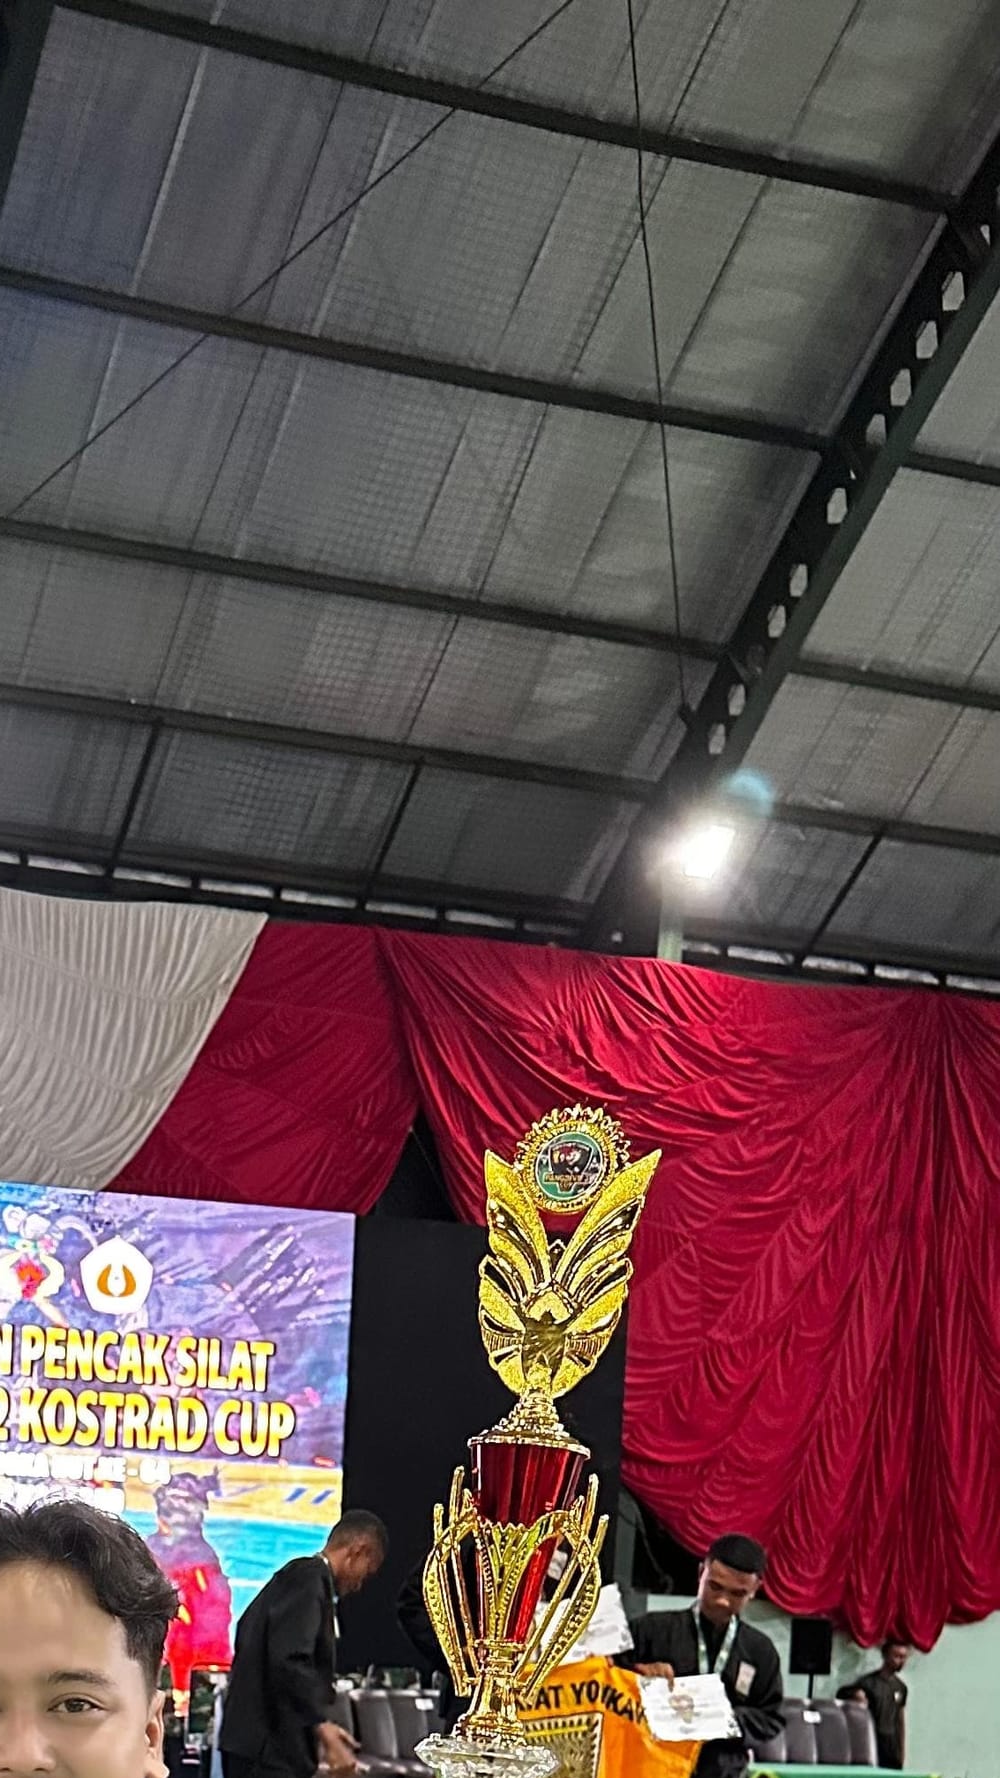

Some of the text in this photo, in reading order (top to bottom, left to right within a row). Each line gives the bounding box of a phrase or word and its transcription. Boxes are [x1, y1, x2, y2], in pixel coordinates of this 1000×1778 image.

[20, 1324, 171, 1387] PENCAK
[175, 1336, 275, 1392] SILAT
[17, 1387, 209, 1453] KOSTRAD
[213, 1398, 296, 1457] CUP
